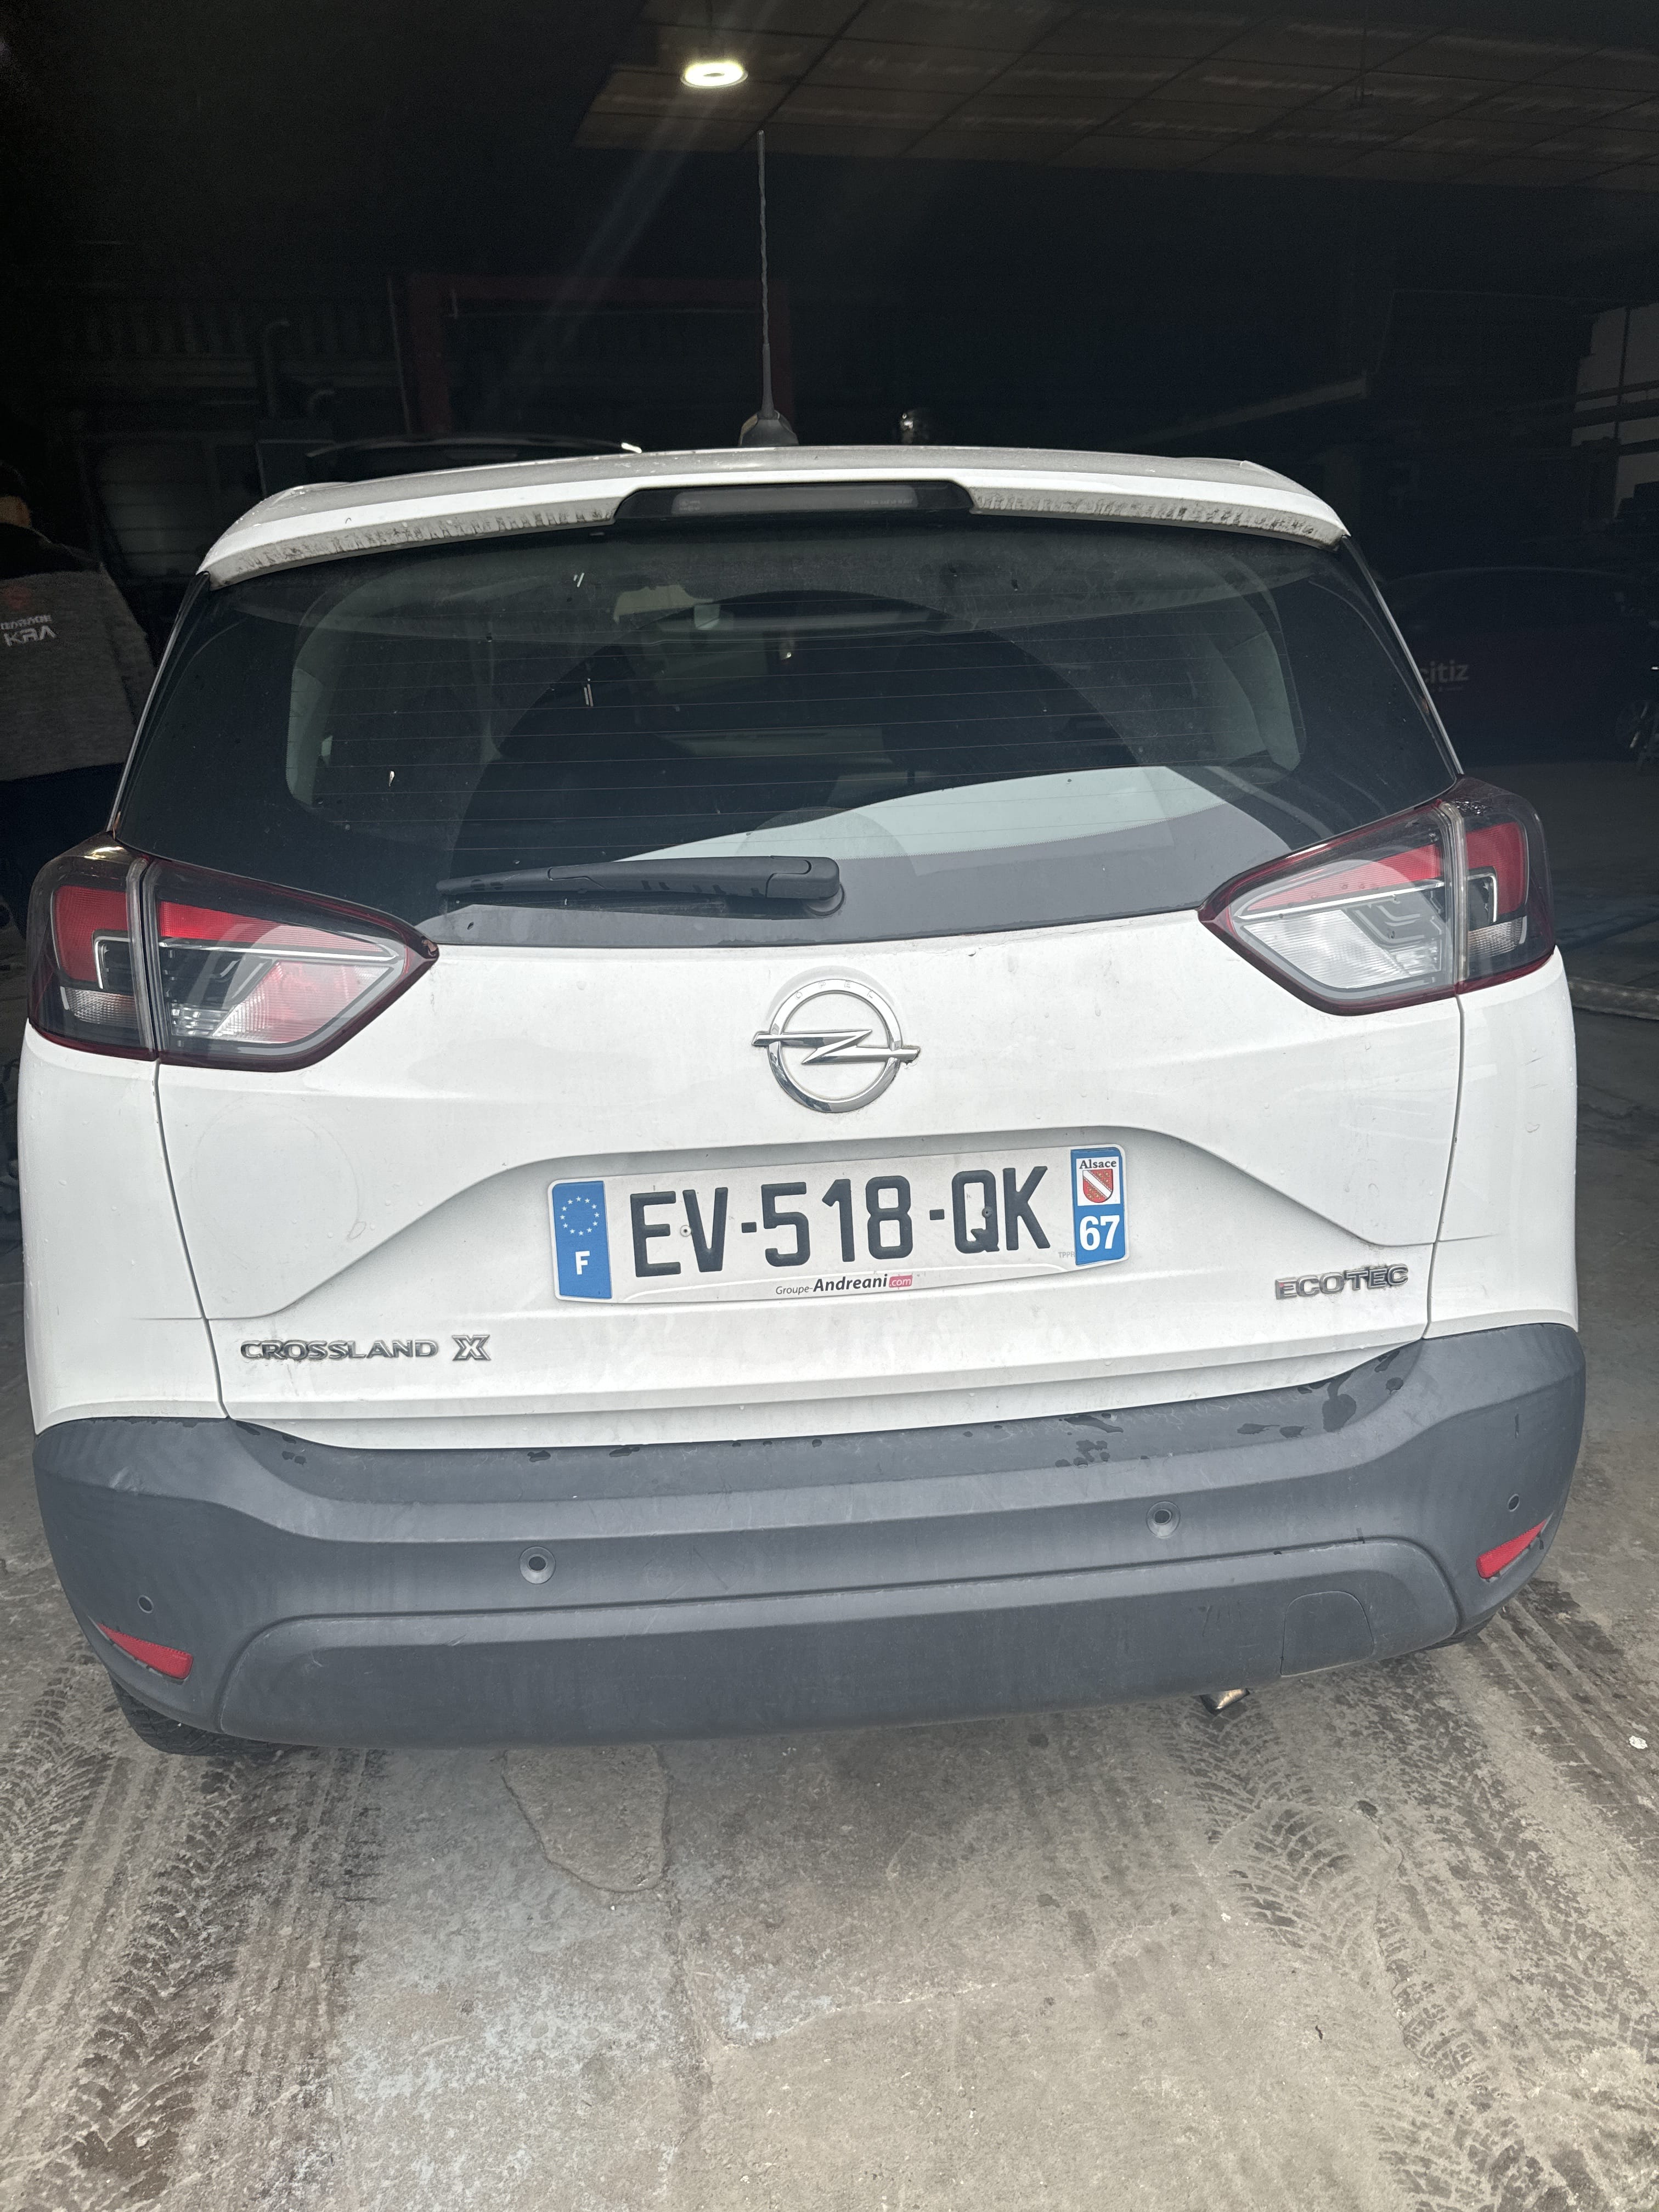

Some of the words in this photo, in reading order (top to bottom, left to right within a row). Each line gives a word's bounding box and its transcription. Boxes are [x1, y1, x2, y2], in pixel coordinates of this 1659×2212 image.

[4, 625, 55, 647] KRA
[1419, 659, 1469, 684] citiz
[794, 980, 874, 1000] OPEL
[1079, 1159, 1116, 1169] Alsace
[630, 1165, 1050, 1278] EV-518-QK
[1080, 1215, 1120, 1251] 67
[575, 1250, 590, 1275] F
[1275, 1263, 1408, 1300] ECOTEC
[240, 1339, 439, 1361] CROSSLAND
[452, 1334, 492, 1362] X
